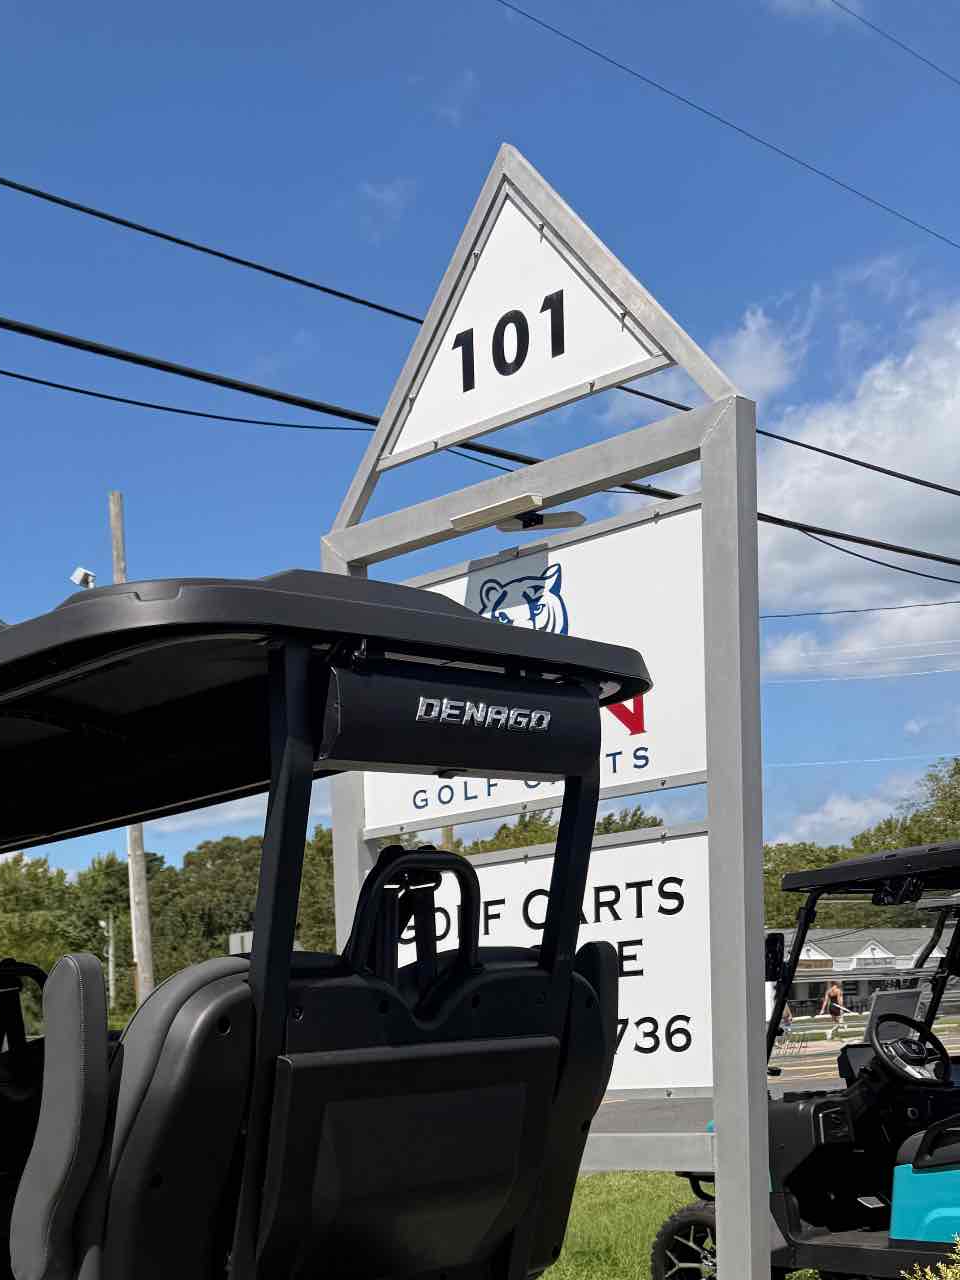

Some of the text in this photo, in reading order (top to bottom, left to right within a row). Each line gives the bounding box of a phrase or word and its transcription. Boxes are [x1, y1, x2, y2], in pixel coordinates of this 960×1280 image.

[451, 288, 565, 393] 101
[416, 696, 551, 731] DENAGO
[522, 876, 685, 930] CRTS
